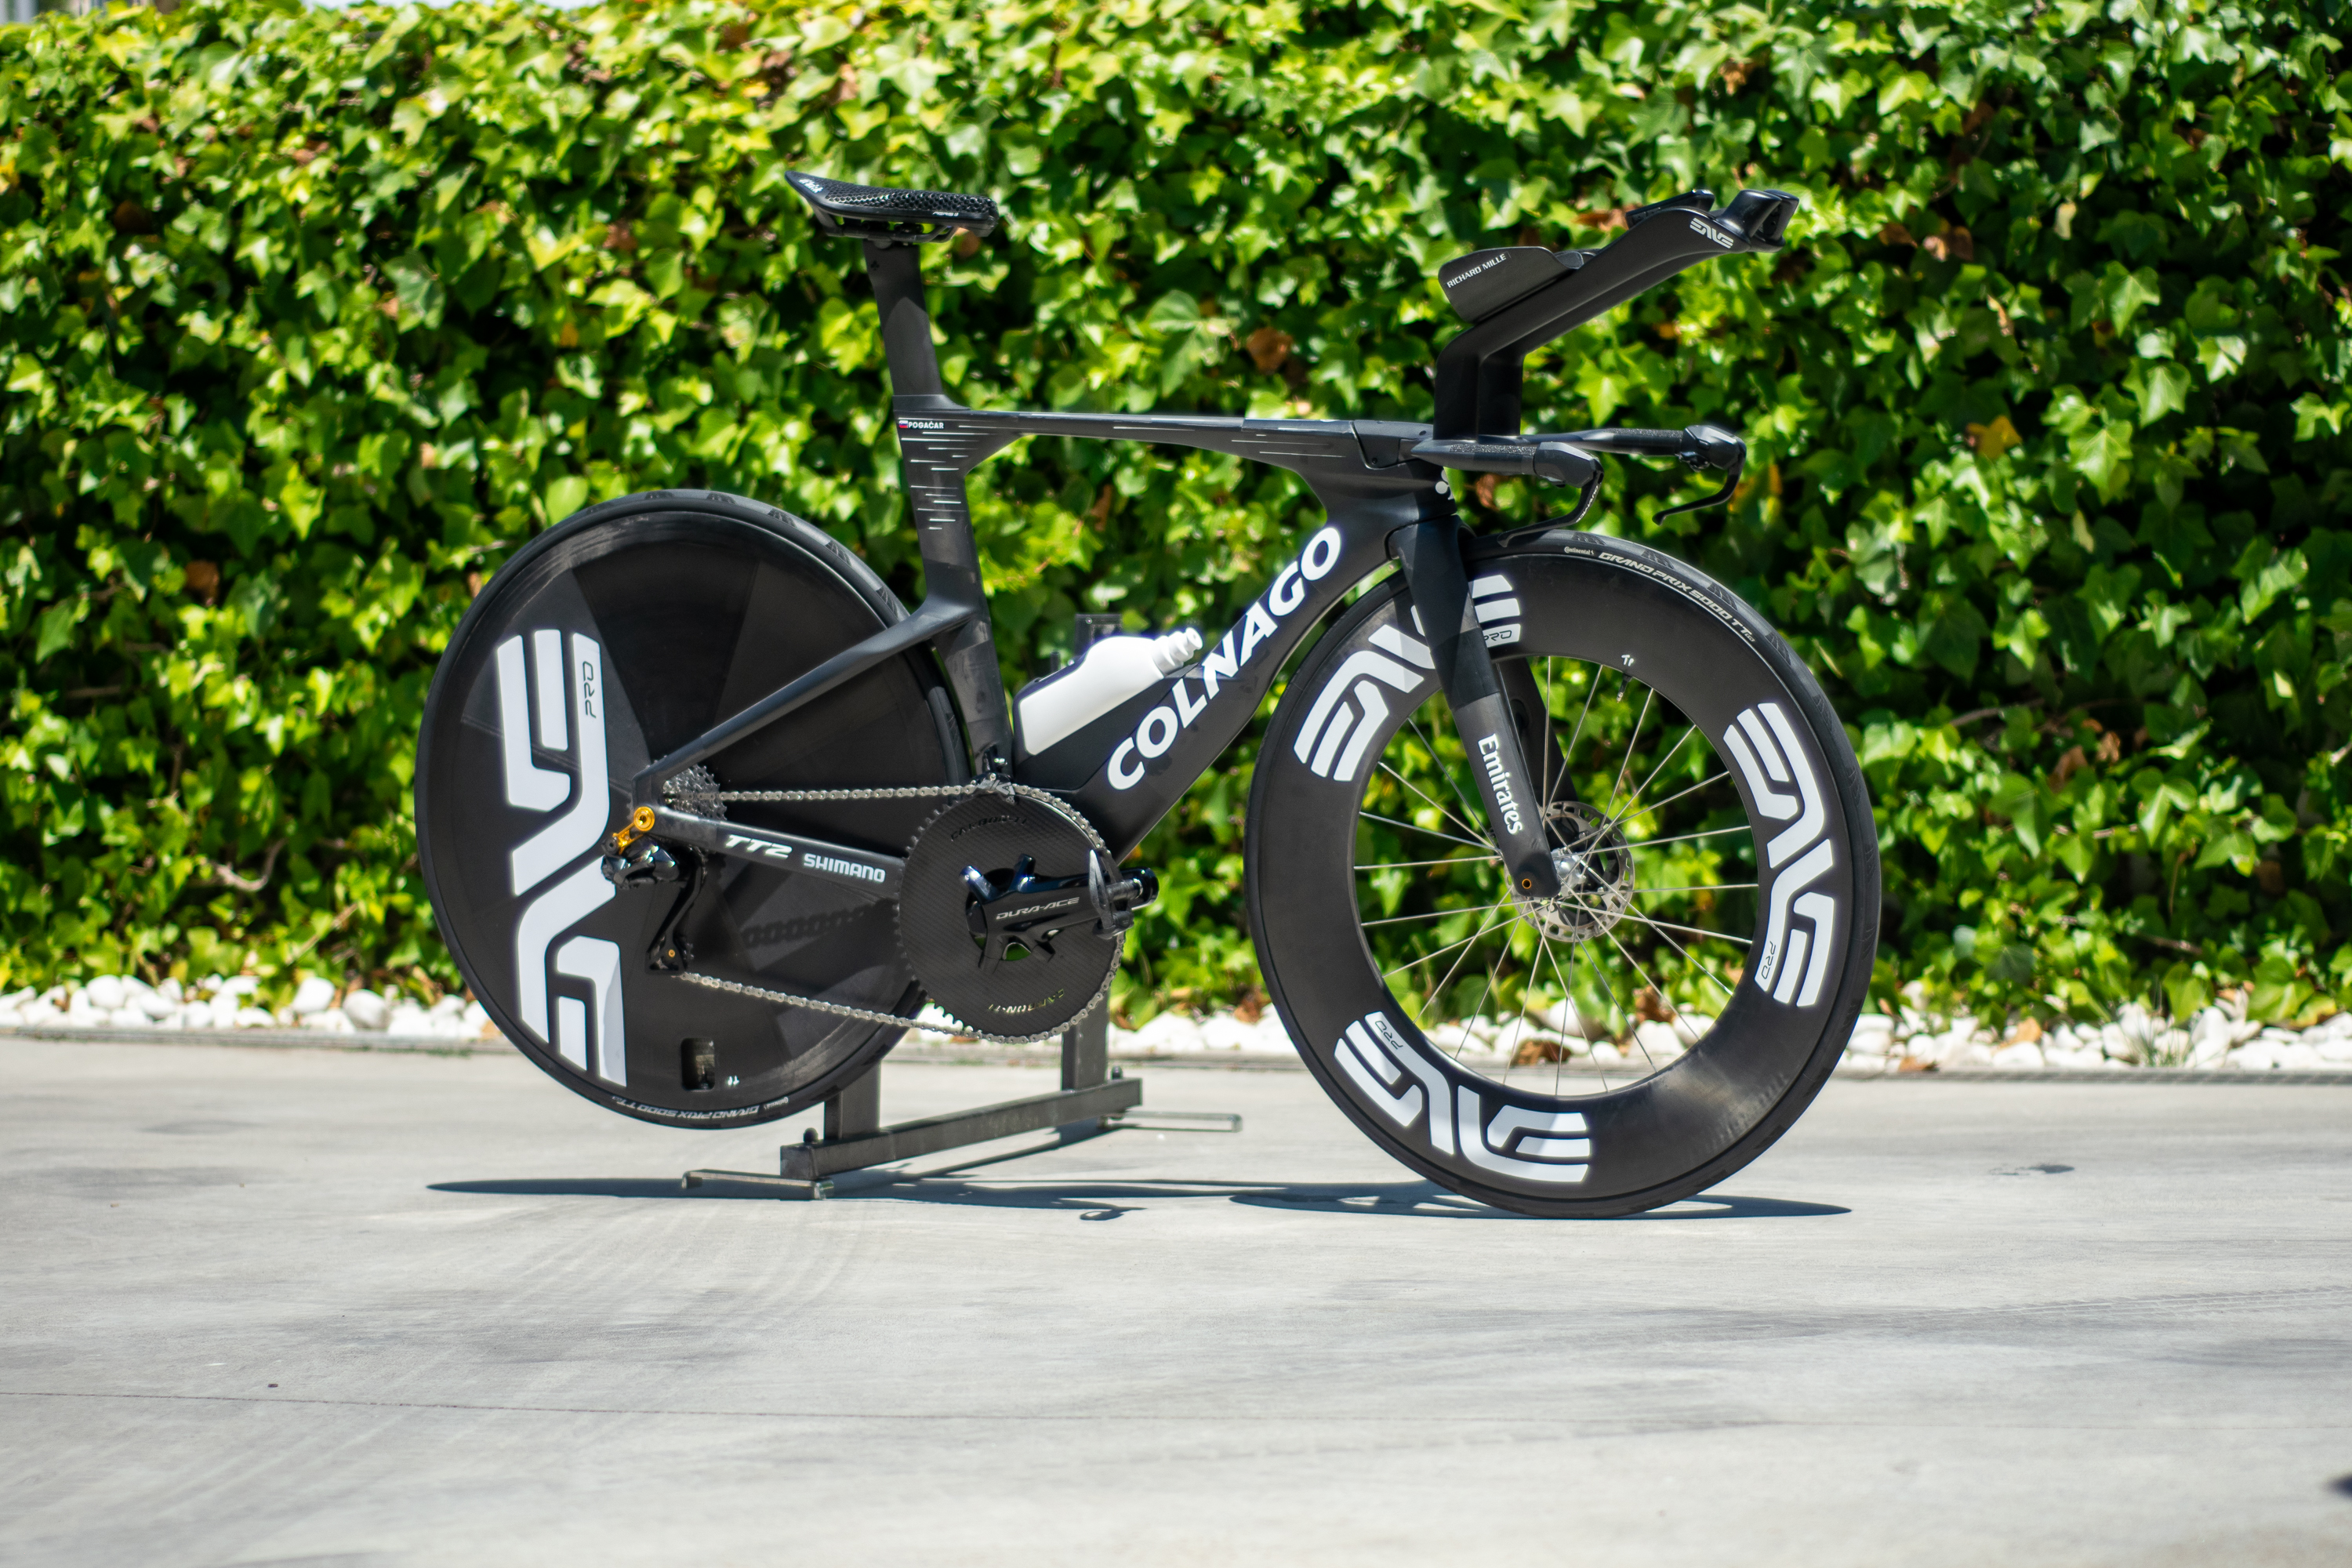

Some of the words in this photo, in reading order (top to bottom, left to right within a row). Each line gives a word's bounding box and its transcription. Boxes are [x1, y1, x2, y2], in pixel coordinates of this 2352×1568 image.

[1690, 217, 1733, 249] ENVE
[1446, 266, 1481, 289] RICHARD
[1482, 253, 1507, 270] MILLE
[1564, 546, 1590, 555] Continental
[1599, 552, 1654, 574] GRAND
[1652, 570, 1692, 592] PRIX
[1689, 589, 1733, 620] 5000
[1107, 527, 1341, 790] COLNAGO
[583, 660, 596, 718] PRO
[1478, 733, 1523, 835] Emirates
[804, 853, 886, 883] SHIMANO
[996, 897, 1080, 920] DURA-ACE
[1761, 941, 1776, 980] PRO
[1375, 1020, 1403, 1050] PRO
[637, 1104, 678, 1117] 5000
[677, 1110, 713, 1120] PRIX
[712, 1105, 760, 1119] GRAND
